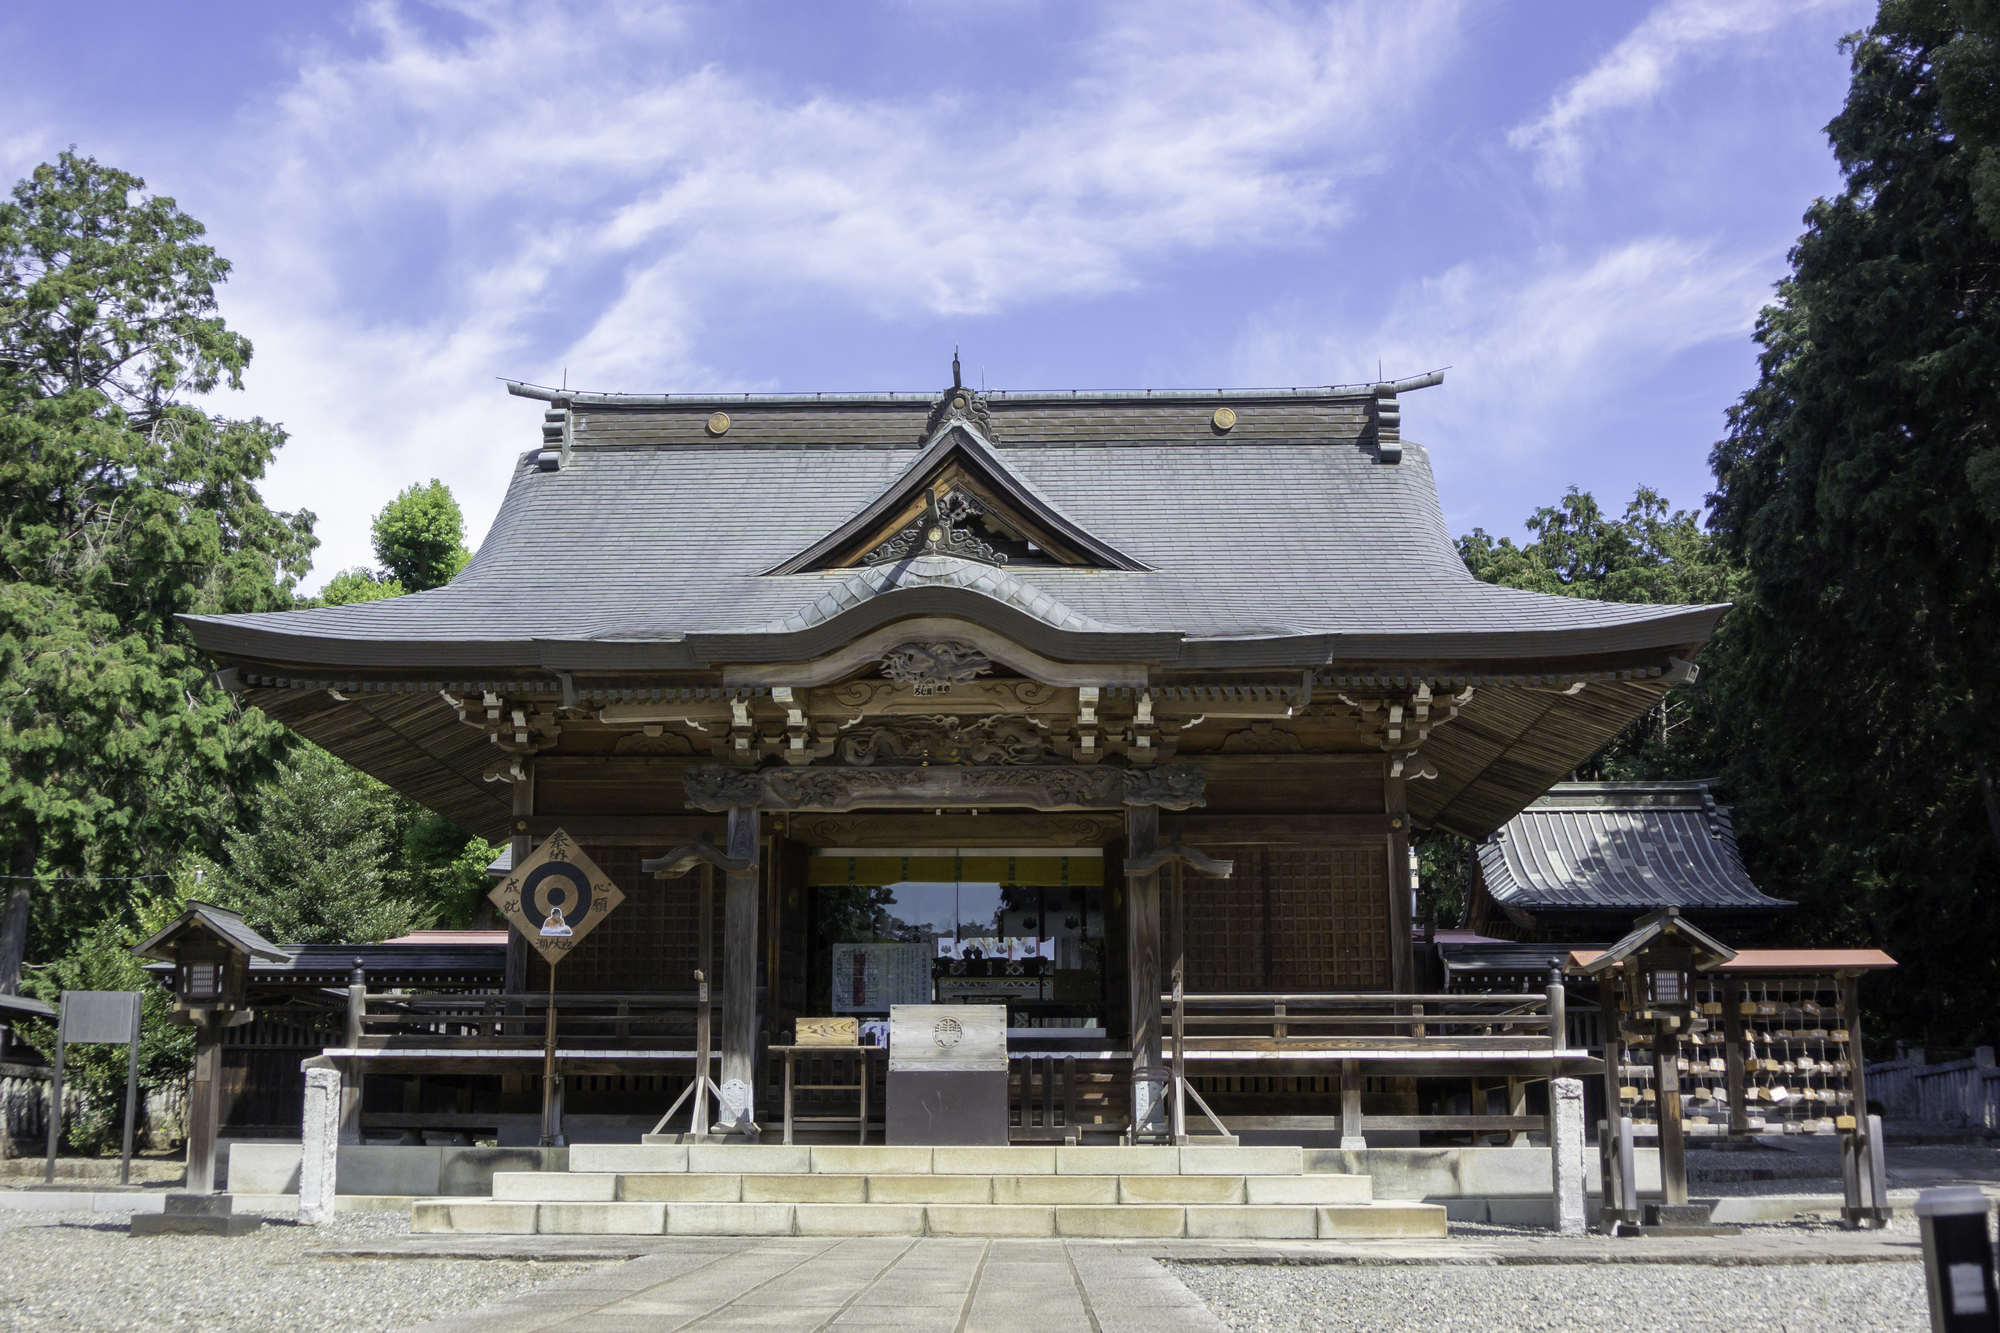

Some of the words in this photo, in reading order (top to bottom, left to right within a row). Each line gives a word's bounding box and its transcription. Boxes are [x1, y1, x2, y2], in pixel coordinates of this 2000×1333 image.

[549, 830, 570, 862] 奉納
[503, 877, 521, 914] 成就
[590, 882, 612, 912] 心願
